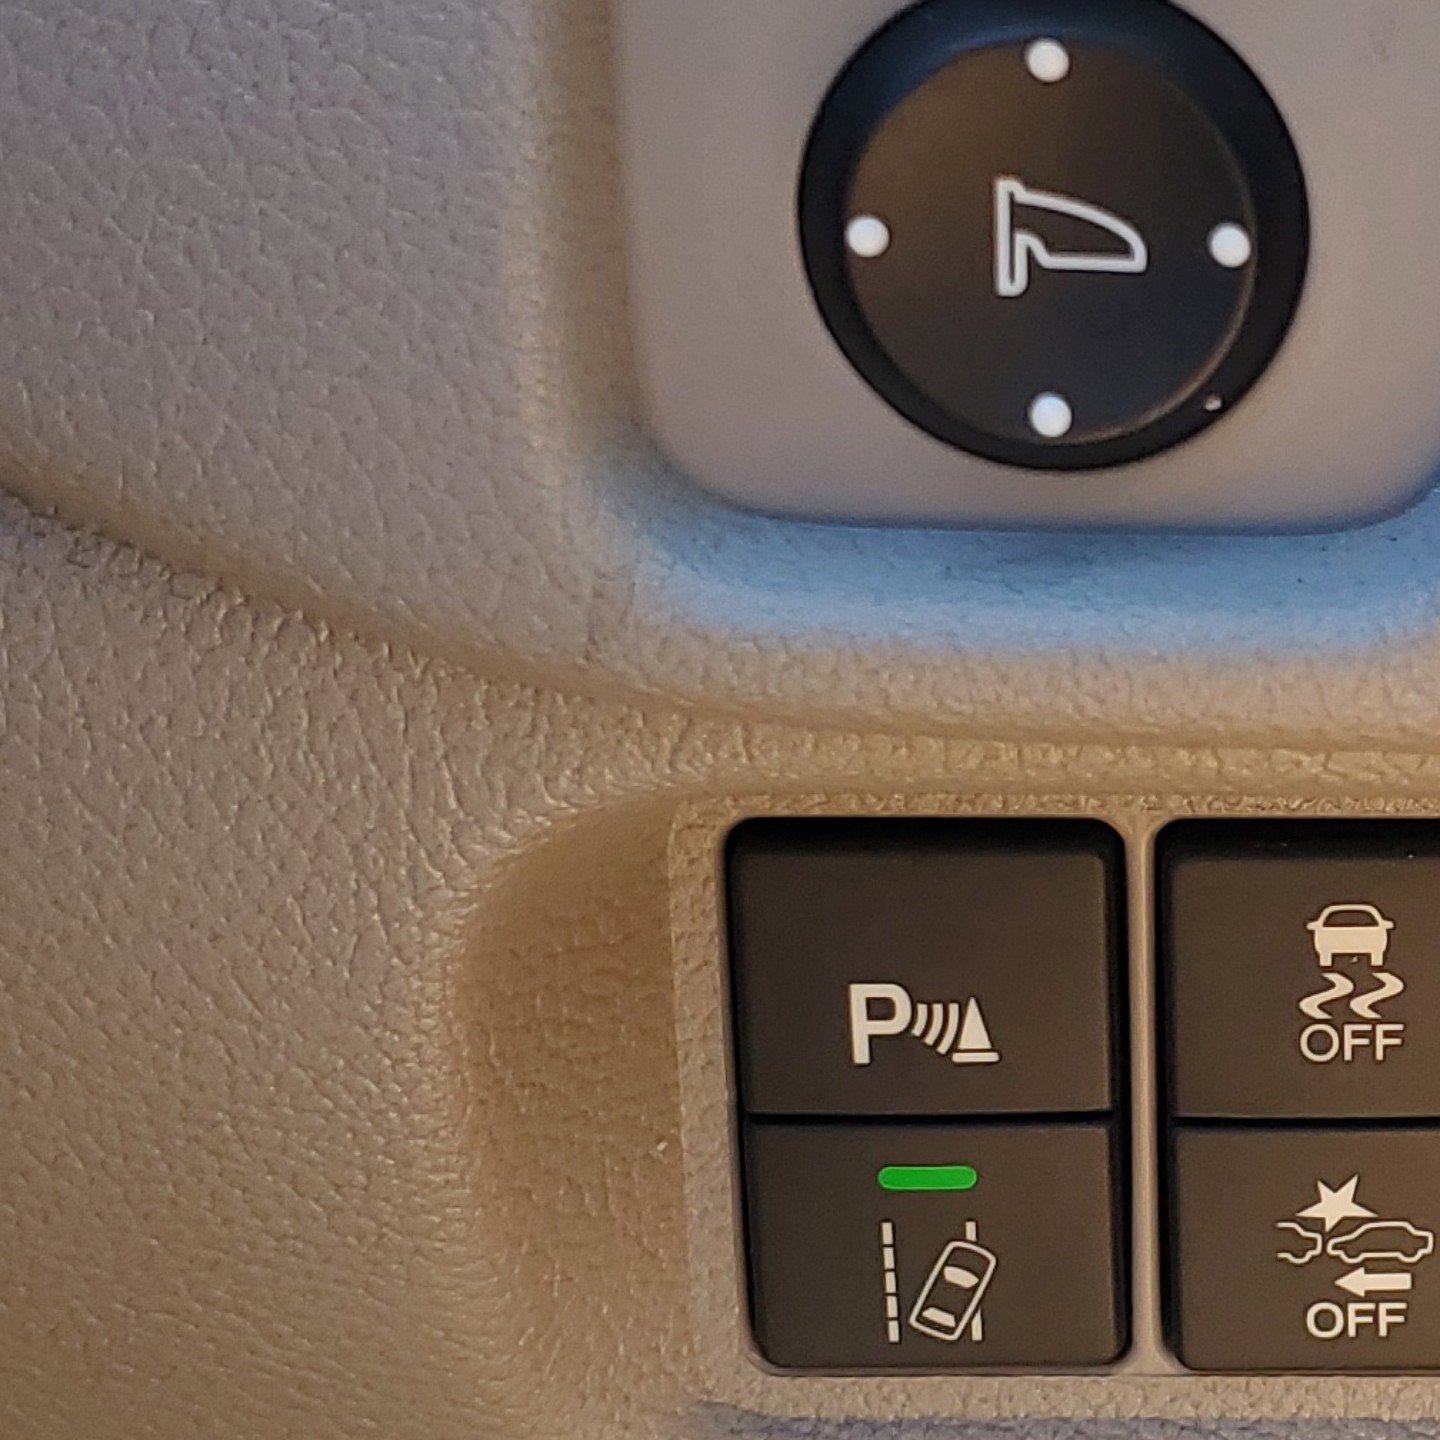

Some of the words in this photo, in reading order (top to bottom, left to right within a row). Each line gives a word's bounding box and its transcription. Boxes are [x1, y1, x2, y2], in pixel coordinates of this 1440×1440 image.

[849, 983, 911, 1064] P
[1299, 1024, 1404, 1063] OFF
[1305, 1301, 1407, 1339] OFF
